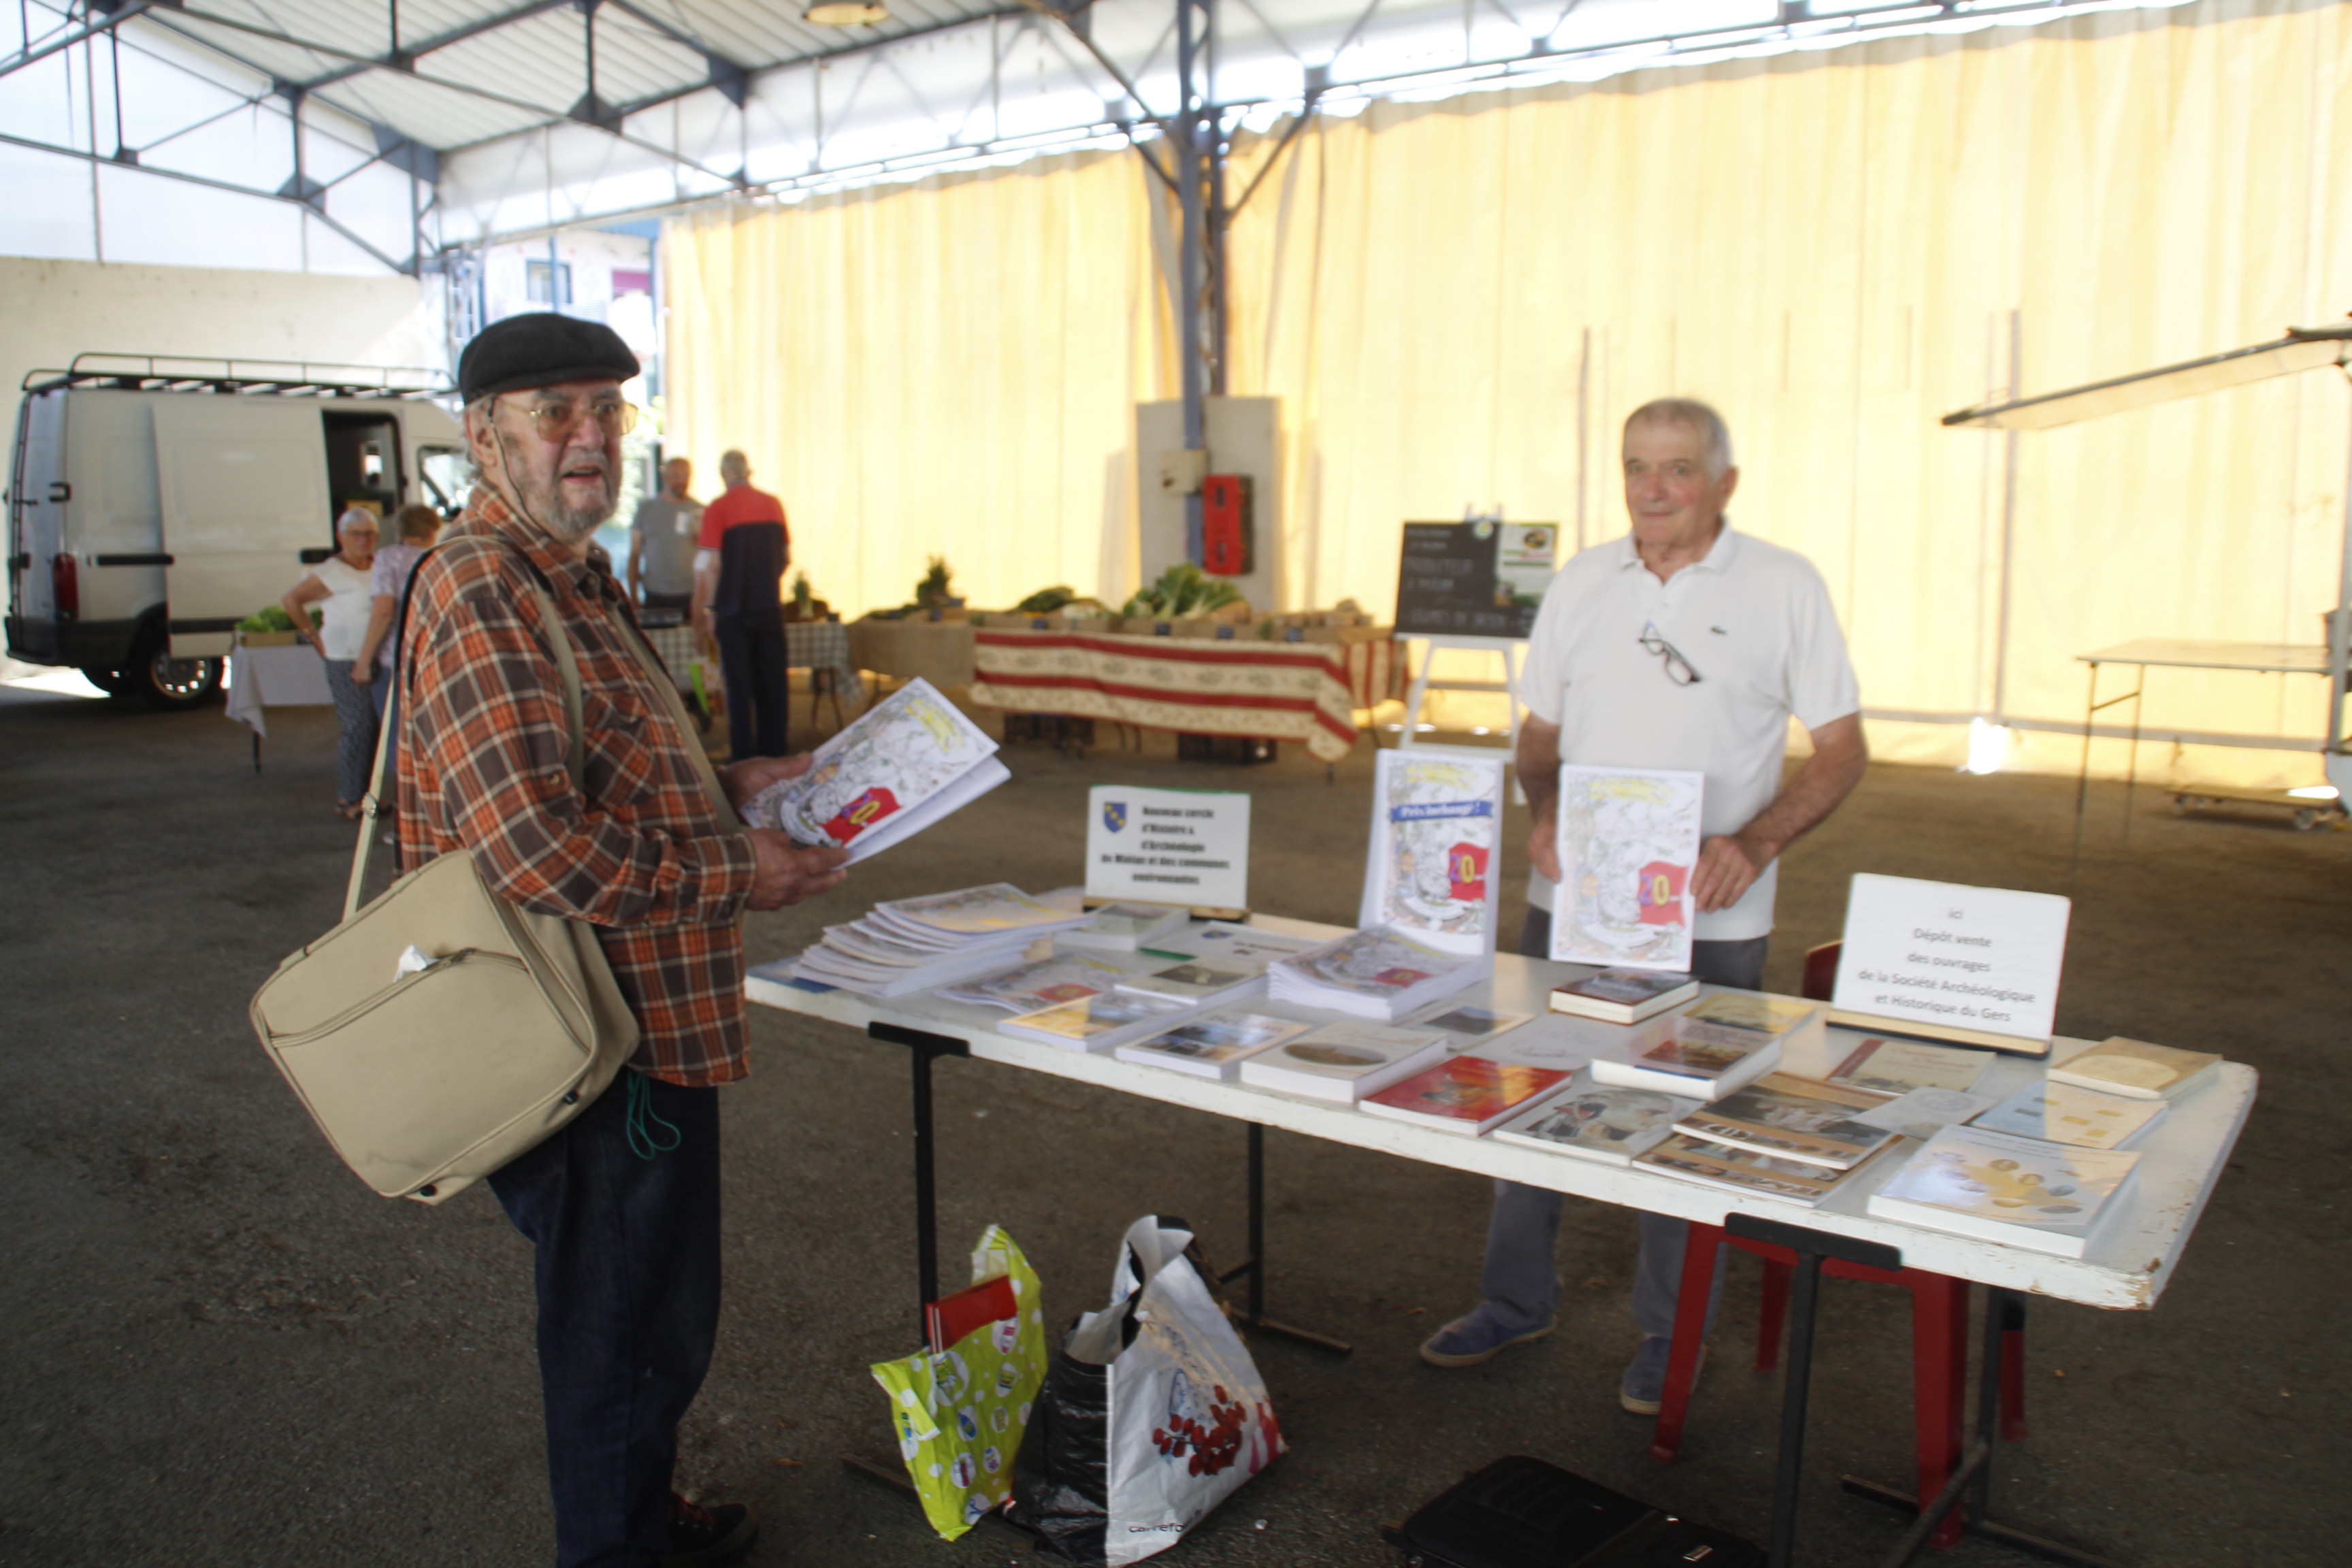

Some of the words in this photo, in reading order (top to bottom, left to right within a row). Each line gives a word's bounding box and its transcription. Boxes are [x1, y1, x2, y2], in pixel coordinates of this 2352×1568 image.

[840, 792, 881, 825] 20
[1401, 807, 1424, 818] Prix
[1449, 855, 1475, 884] 20
[1638, 873, 1670, 906] 20
[1948, 906, 1964, 919] ici
[1914, 926, 1952, 944] Dépôt
[1955, 934, 1993, 948] vente
[1907, 951, 1930, 964] des
[1933, 956, 1992, 973] ouvrages
[1859, 968, 1875, 981] de
[1877, 969, 1889, 983] la
[1892, 973, 1938, 990] Société
[1940, 980, 2036, 1003] Archéologique
[1875, 994, 1889, 1005] et
[1892, 995, 1957, 1015] Historique
[1960, 1004, 1978, 1017] du
[1982, 1007, 2012, 1022] Gers
